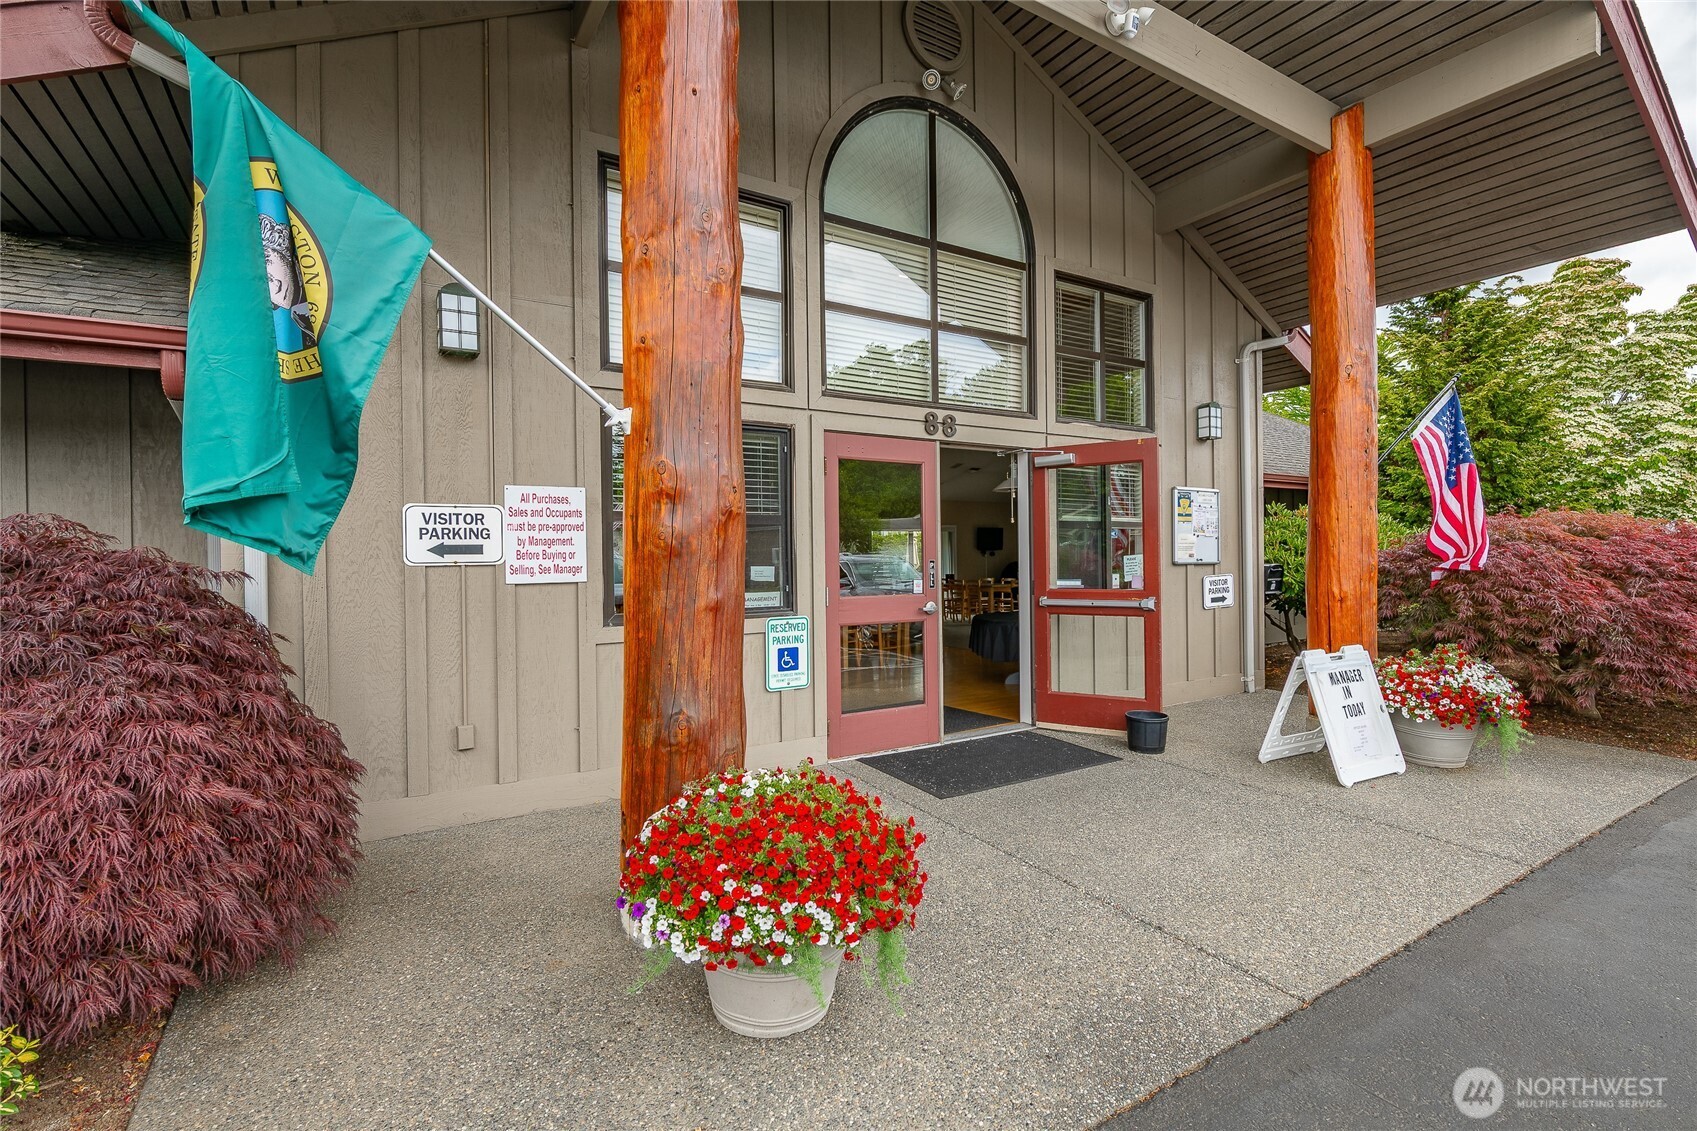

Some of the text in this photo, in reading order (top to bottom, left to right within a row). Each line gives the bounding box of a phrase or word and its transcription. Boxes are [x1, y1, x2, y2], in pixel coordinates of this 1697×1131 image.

[924, 411, 957, 437] 88
[520, 493, 571, 506] All Purchases,
[421, 512, 485, 525] VISITOR
[508, 506, 583, 520] Sales and Occupants
[419, 527, 490, 540] PARKING
[507, 521, 584, 534] must be pre-approved
[517, 536, 575, 549] by Management.
[516, 550, 576, 562] Before Buying or
[538, 564, 552, 575] See
[553, 564, 583, 576] Manager
[1209, 579, 1228, 587] VISITOR
[1209, 587, 1230, 595] PARKING
[770, 622, 806, 633] RESERVED
[772, 634, 805, 646] PARKING
[1328, 669, 1364, 685] MANAGER
[1342, 686, 1352, 699] IN
[1342, 702, 1366, 719] TODAY
